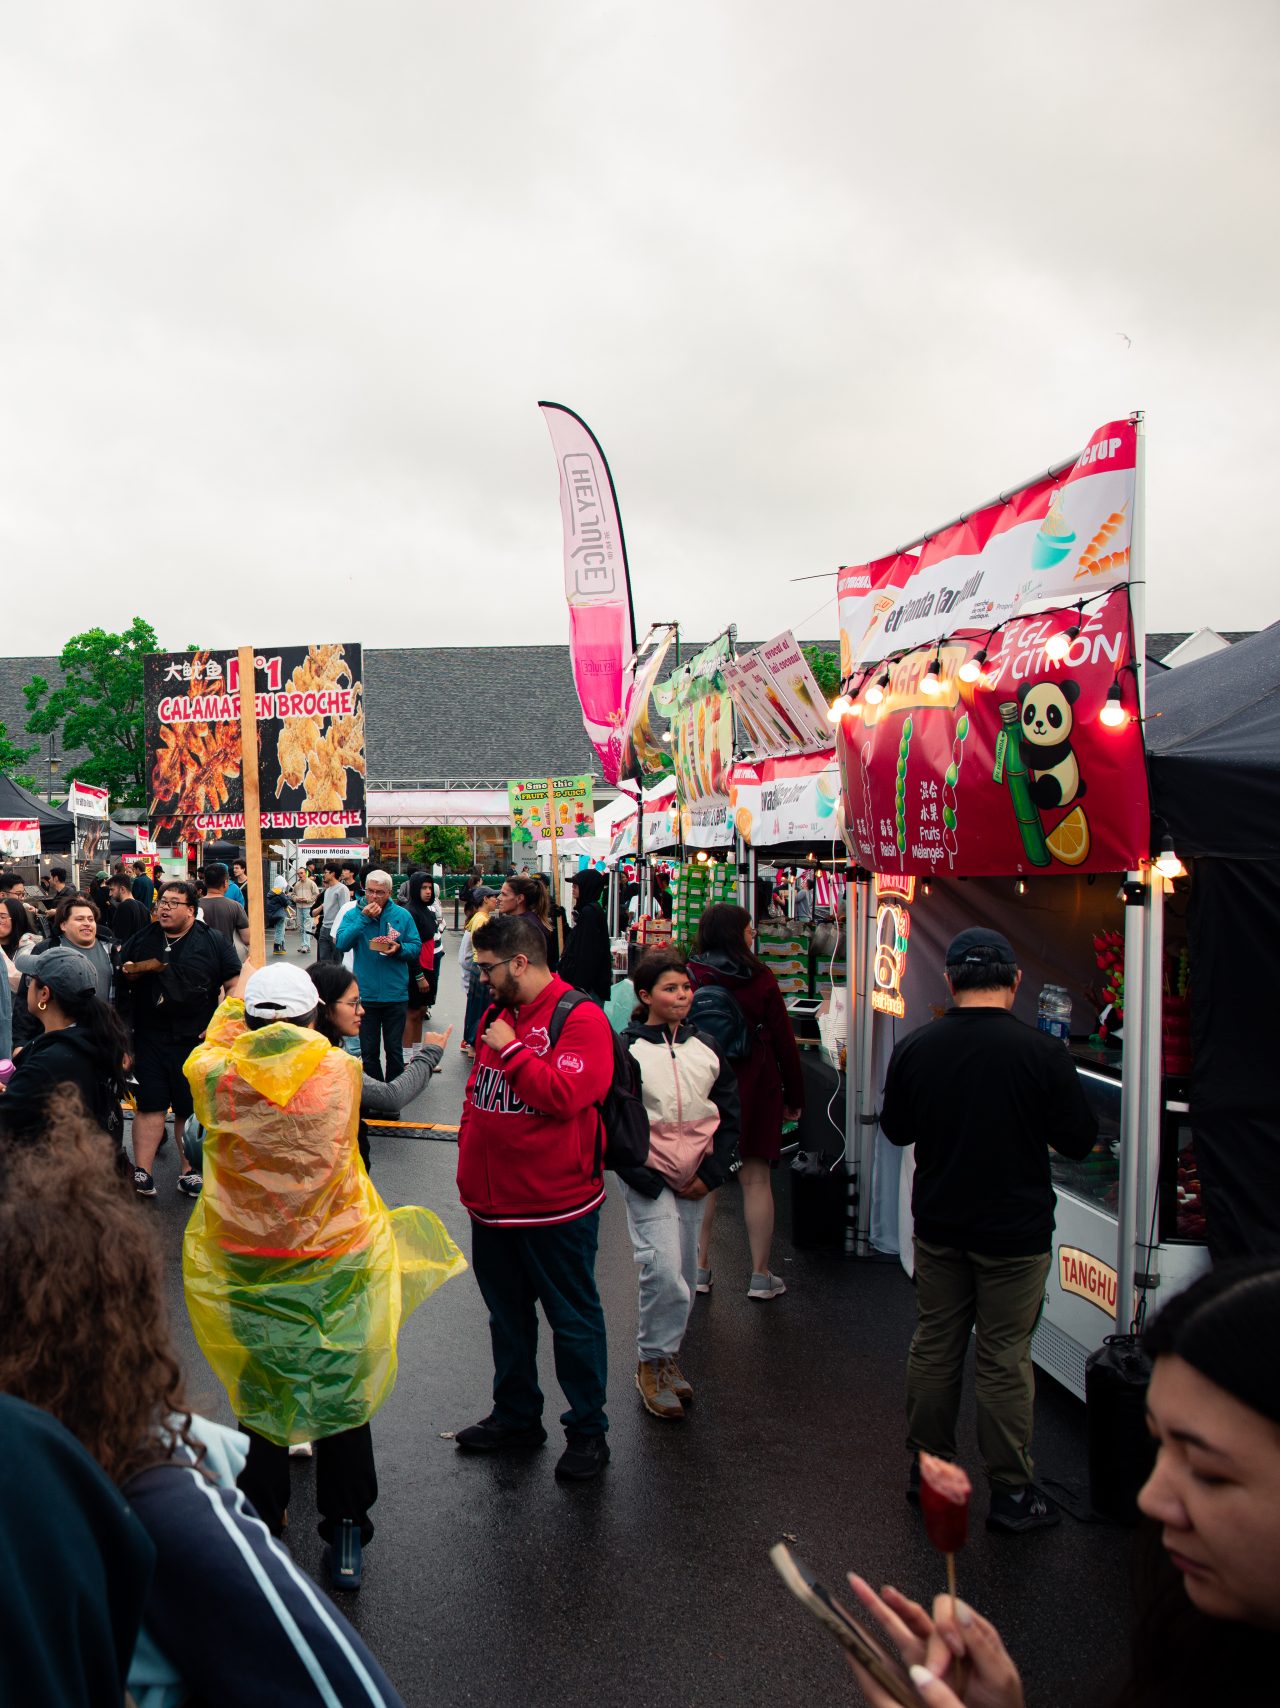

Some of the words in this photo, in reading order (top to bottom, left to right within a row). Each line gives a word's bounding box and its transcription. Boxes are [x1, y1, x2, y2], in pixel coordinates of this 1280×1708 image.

[277, 690, 352, 717] BROCHE
[526, 780, 573, 790] Smothie
[195, 813, 269, 829] CALAMR
[272, 812, 292, 828] EN
[296, 811, 360, 827] BROCHE
[920, 826, 940, 840] Fruits
[1062, 1256, 1117, 1306] TANGHU
